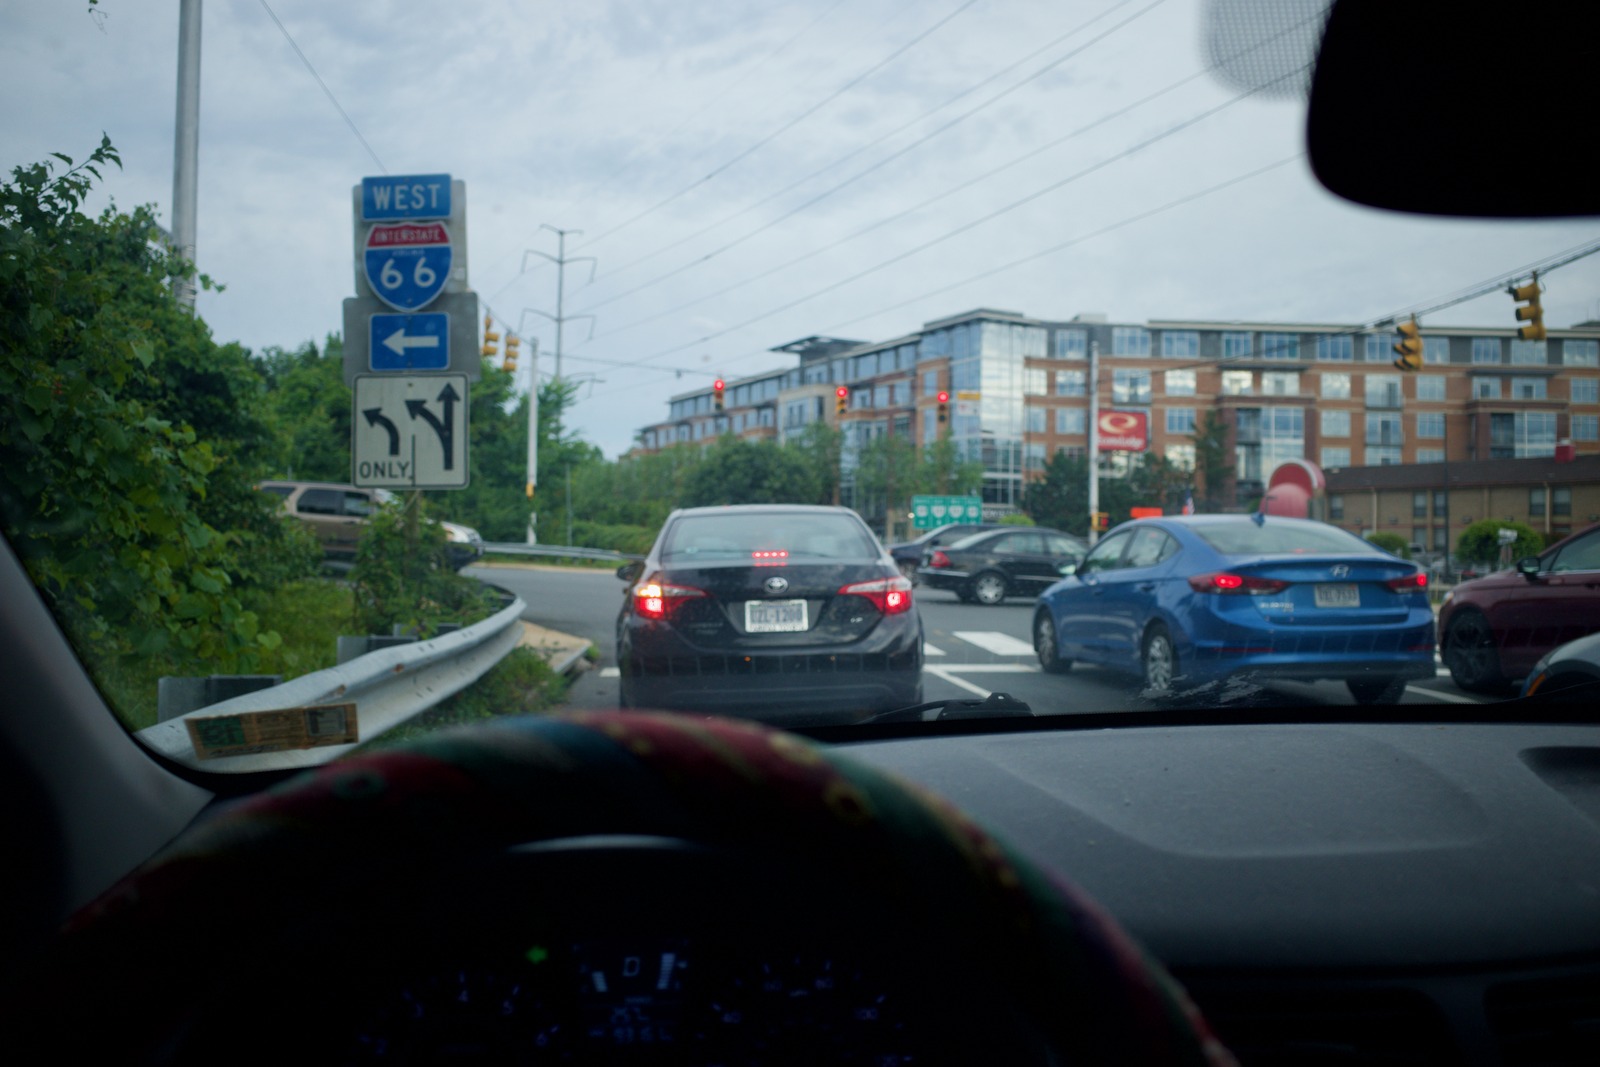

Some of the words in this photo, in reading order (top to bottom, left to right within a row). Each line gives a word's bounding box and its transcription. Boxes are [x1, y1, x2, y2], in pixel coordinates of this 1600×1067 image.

[372, 183, 441, 211] WEST
[374, 229, 441, 243] INTERSTATE
[380, 256, 437, 290] 66
[359, 461, 410, 479] ONLY
